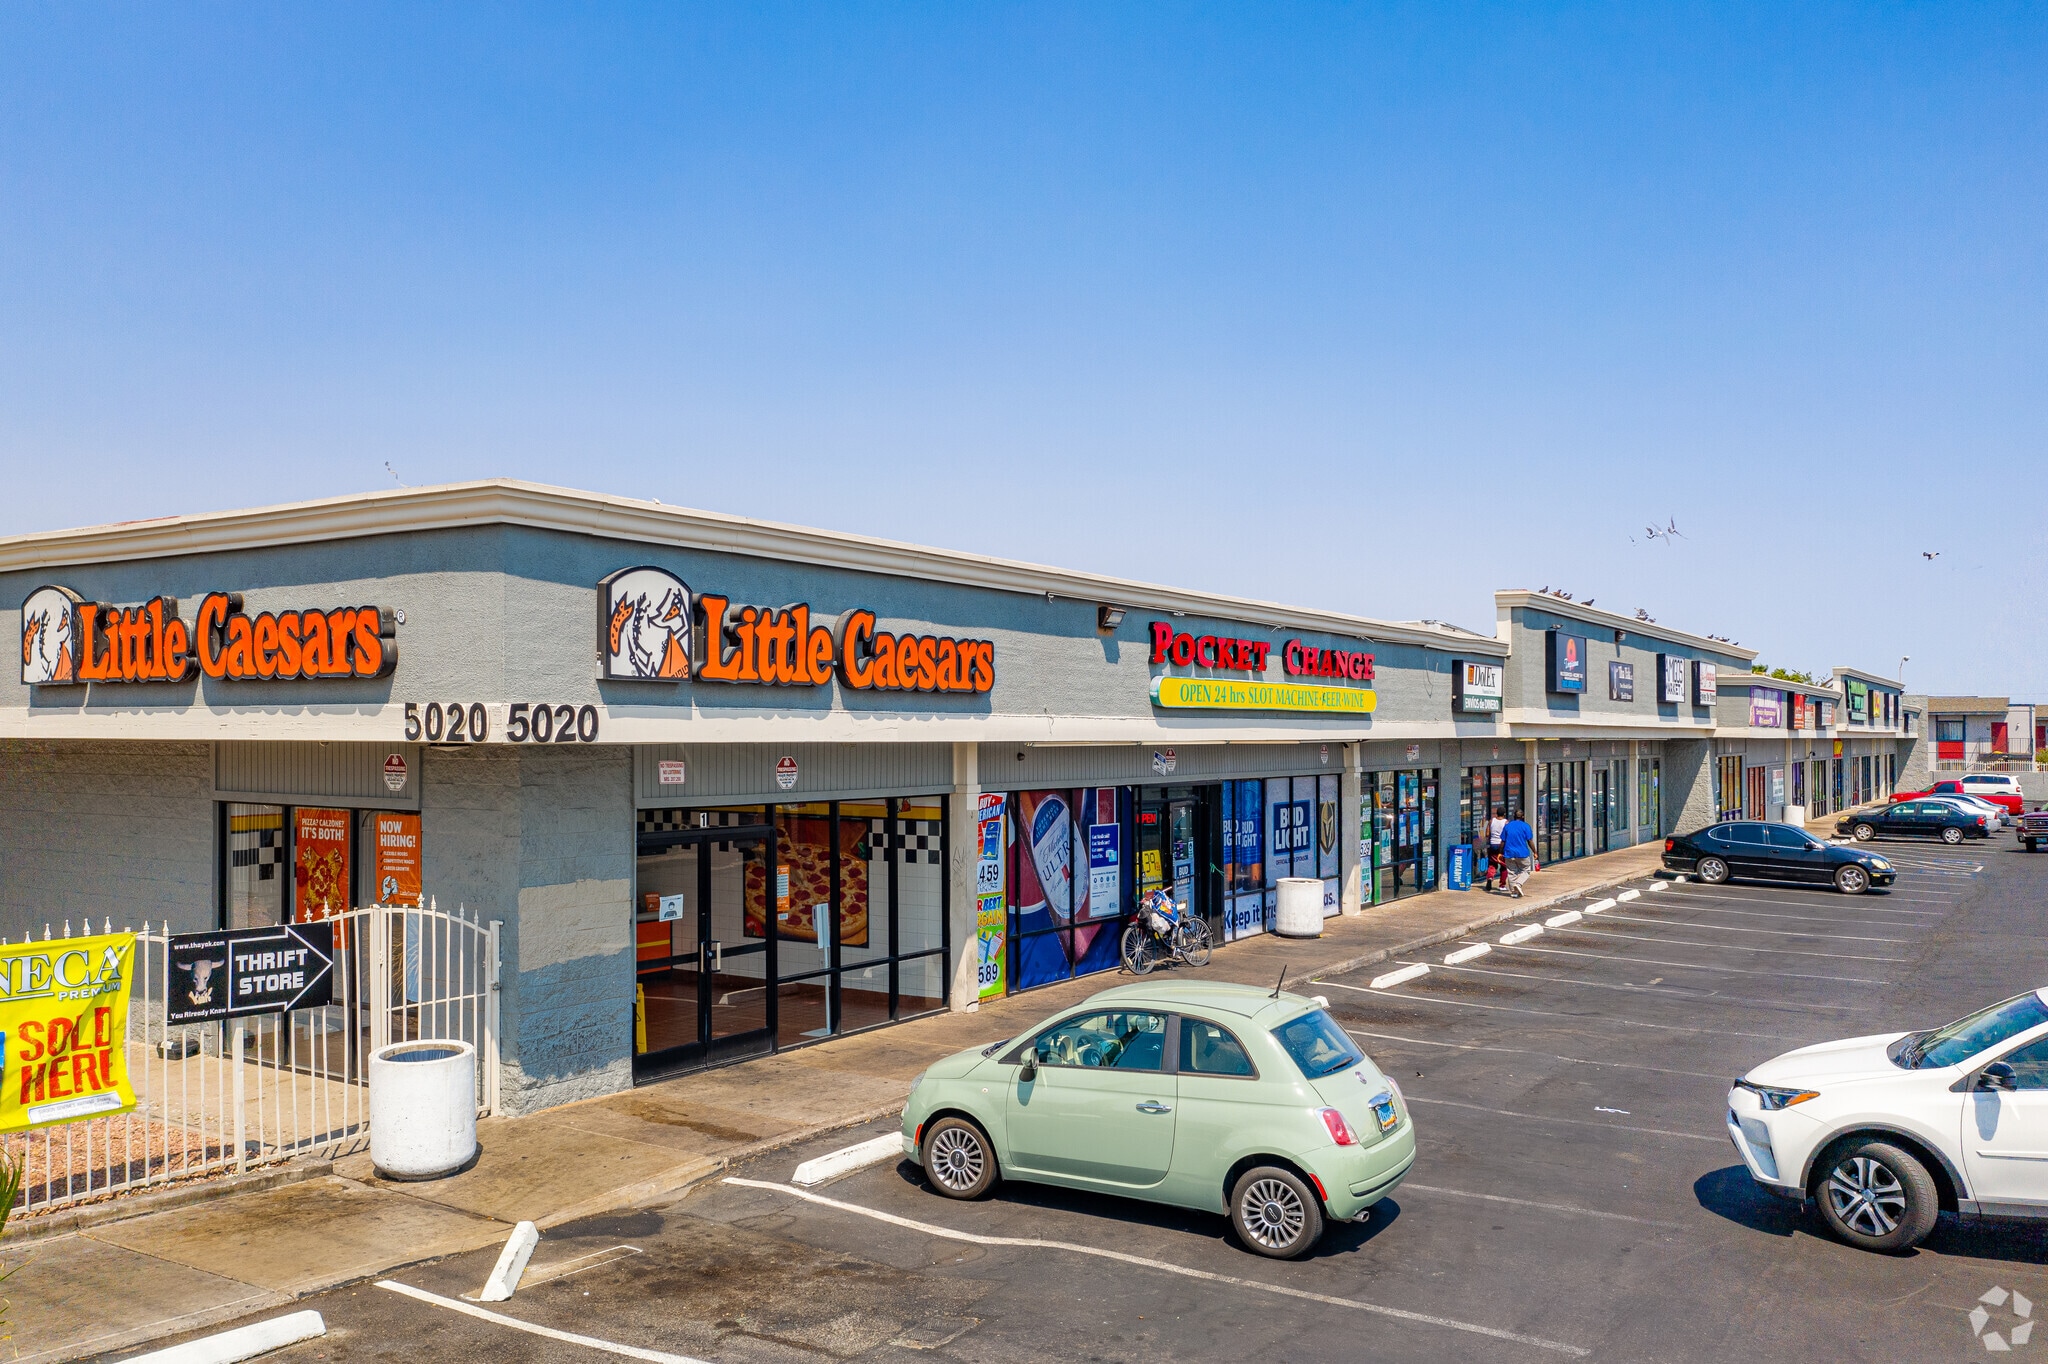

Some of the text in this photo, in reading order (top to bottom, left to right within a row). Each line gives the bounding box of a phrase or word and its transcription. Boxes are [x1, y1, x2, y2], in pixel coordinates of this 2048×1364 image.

[78, 591, 387, 682] Little Caesars
[700, 594, 995, 693] Little Caesars
[1150, 621, 1376, 680] POCKET CHANGE
[1180, 683, 1211, 703] OPEN
[1214, 685, 1227, 703] 24
[1229, 687, 1245, 704] hrs
[1248, 687, 1273, 705] SLOT
[404, 702, 488, 742] 5020
[506, 703, 598, 743] 5020
[302, 818, 344, 828] PIZZA? CALZONE?
[978, 805, 1001, 822] ERICAN
[301, 826, 344, 841] IT'S BOTH!
[380, 821, 402, 833] NOW
[380, 834, 416, 848] HIRING!
[1223, 832, 1241, 846] IGT
[1042, 836, 1077, 881] ULTR
[983, 896, 1002, 911] BEST
[1253, 904, 1260, 922] it
[977, 909, 1003, 927] RGAIN
[234, 948, 308, 973] THRIFT
[58, 981, 121, 1001] PREMUM
[239, 971, 304, 995] STORE
[171, 1007, 227, 1020] You Already Know
[18, 1007, 112, 1062] SOLD
[19, 1047, 119, 1105] HERE
